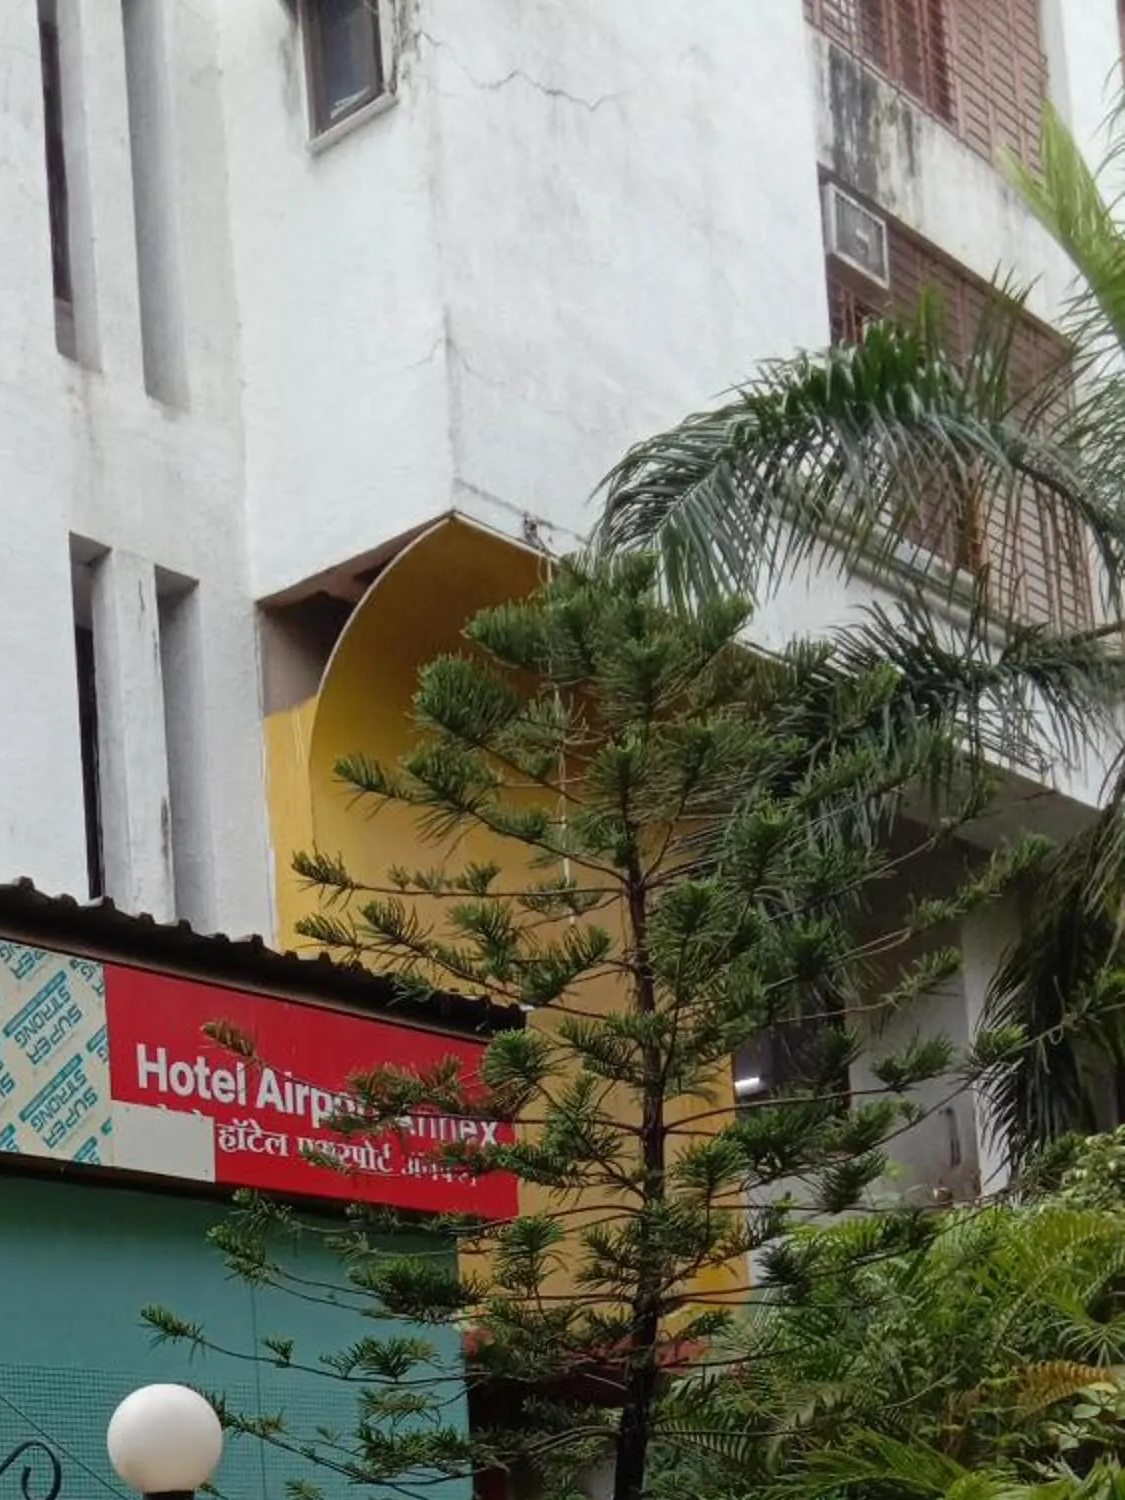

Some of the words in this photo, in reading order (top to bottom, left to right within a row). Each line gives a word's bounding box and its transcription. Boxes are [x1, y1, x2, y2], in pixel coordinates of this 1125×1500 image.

[14, 985, 71, 1048] STRONG
[26, 1003, 82, 1065] SUPER
[30, 1069, 87, 1132] STRONG
[136, 1043, 247, 1106] Hotel
[255, 1067, 381, 1128] Airpo
[43, 1086, 98, 1149] SUPER
